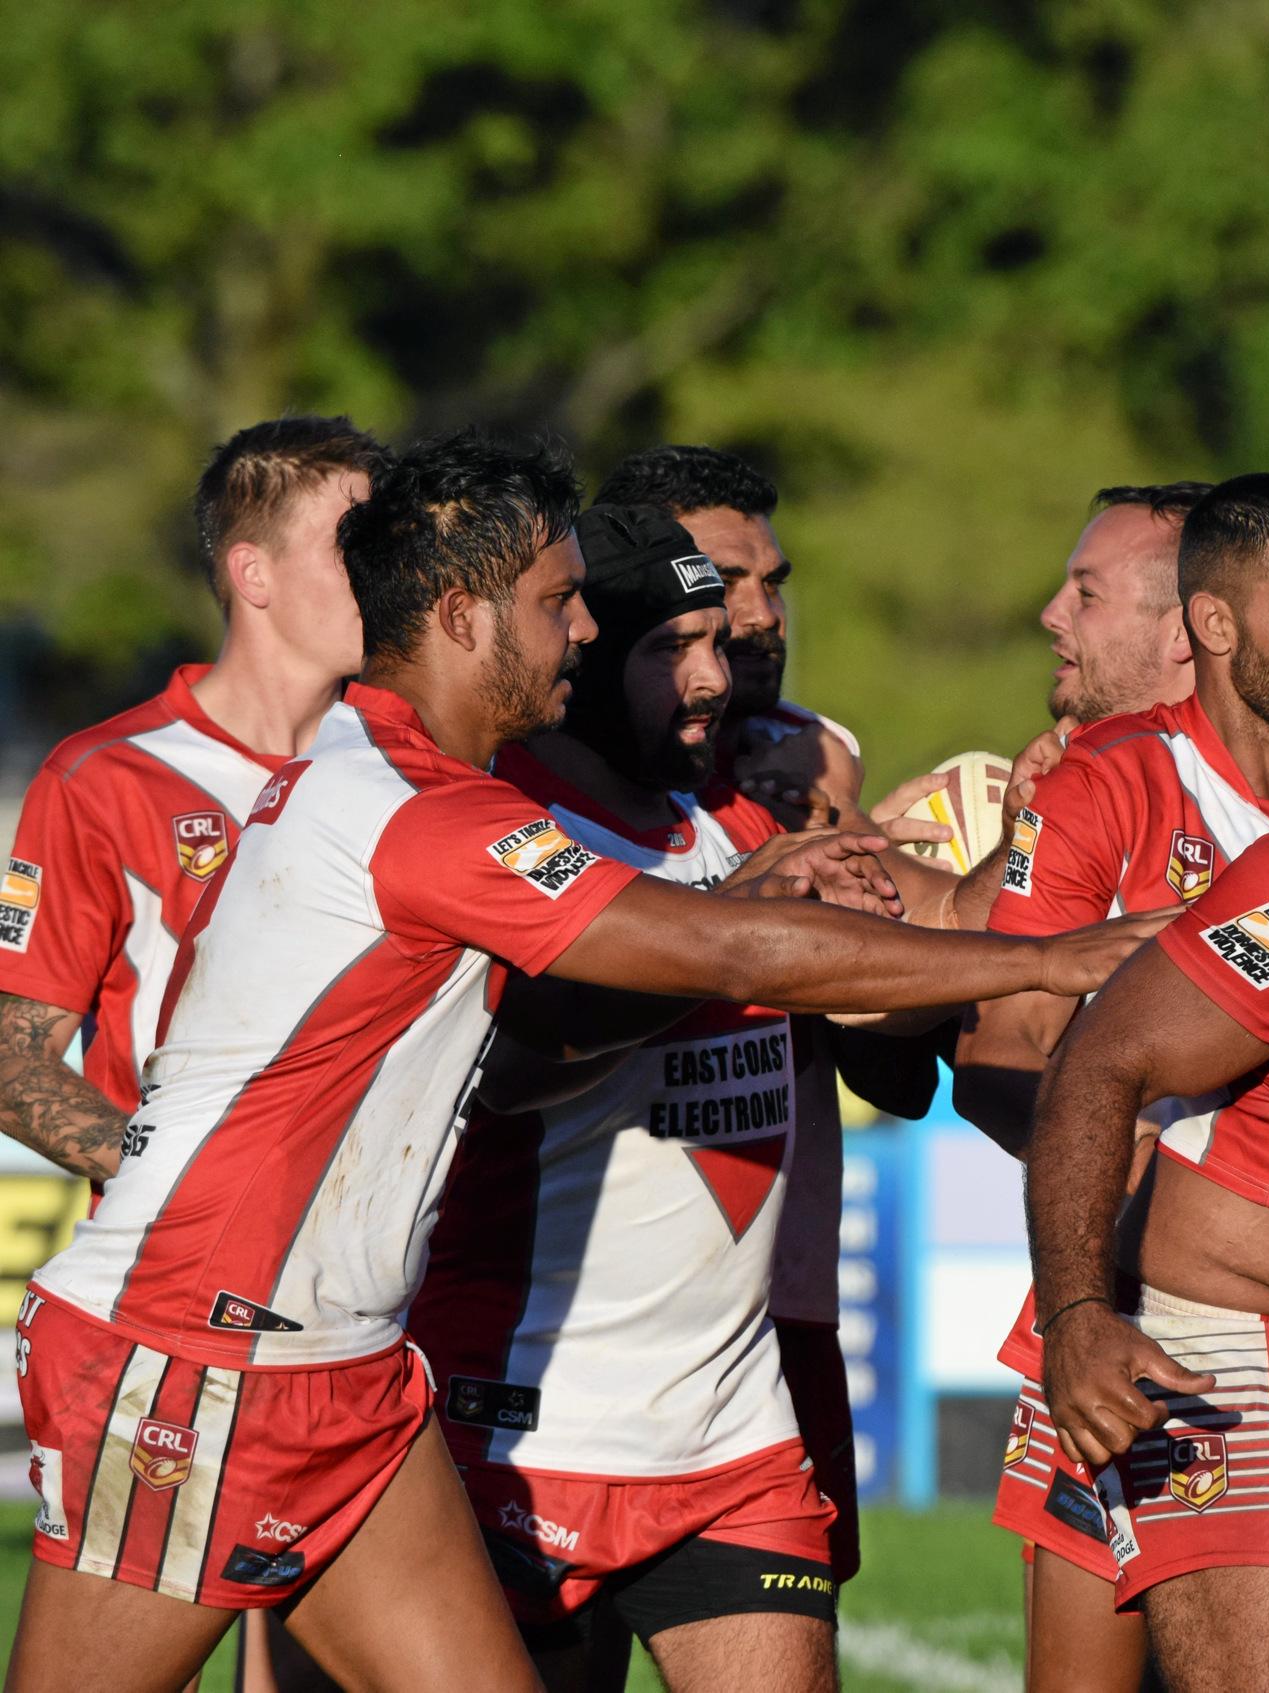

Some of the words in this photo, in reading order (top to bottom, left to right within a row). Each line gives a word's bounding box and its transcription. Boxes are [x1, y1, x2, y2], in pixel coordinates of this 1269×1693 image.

[178, 818, 221, 838] CRL
[492, 833, 522, 856] LET'S
[664, 1046, 729, 1087] EAST
[228, 1303, 251, 1320] CRL
[460, 1385, 480, 1398] CRL
[498, 1408, 533, 1425] CSM
[143, 1426, 188, 1453] CRL
[1174, 1441, 1221, 1462] CRL
[524, 1514, 580, 1551] CSM
